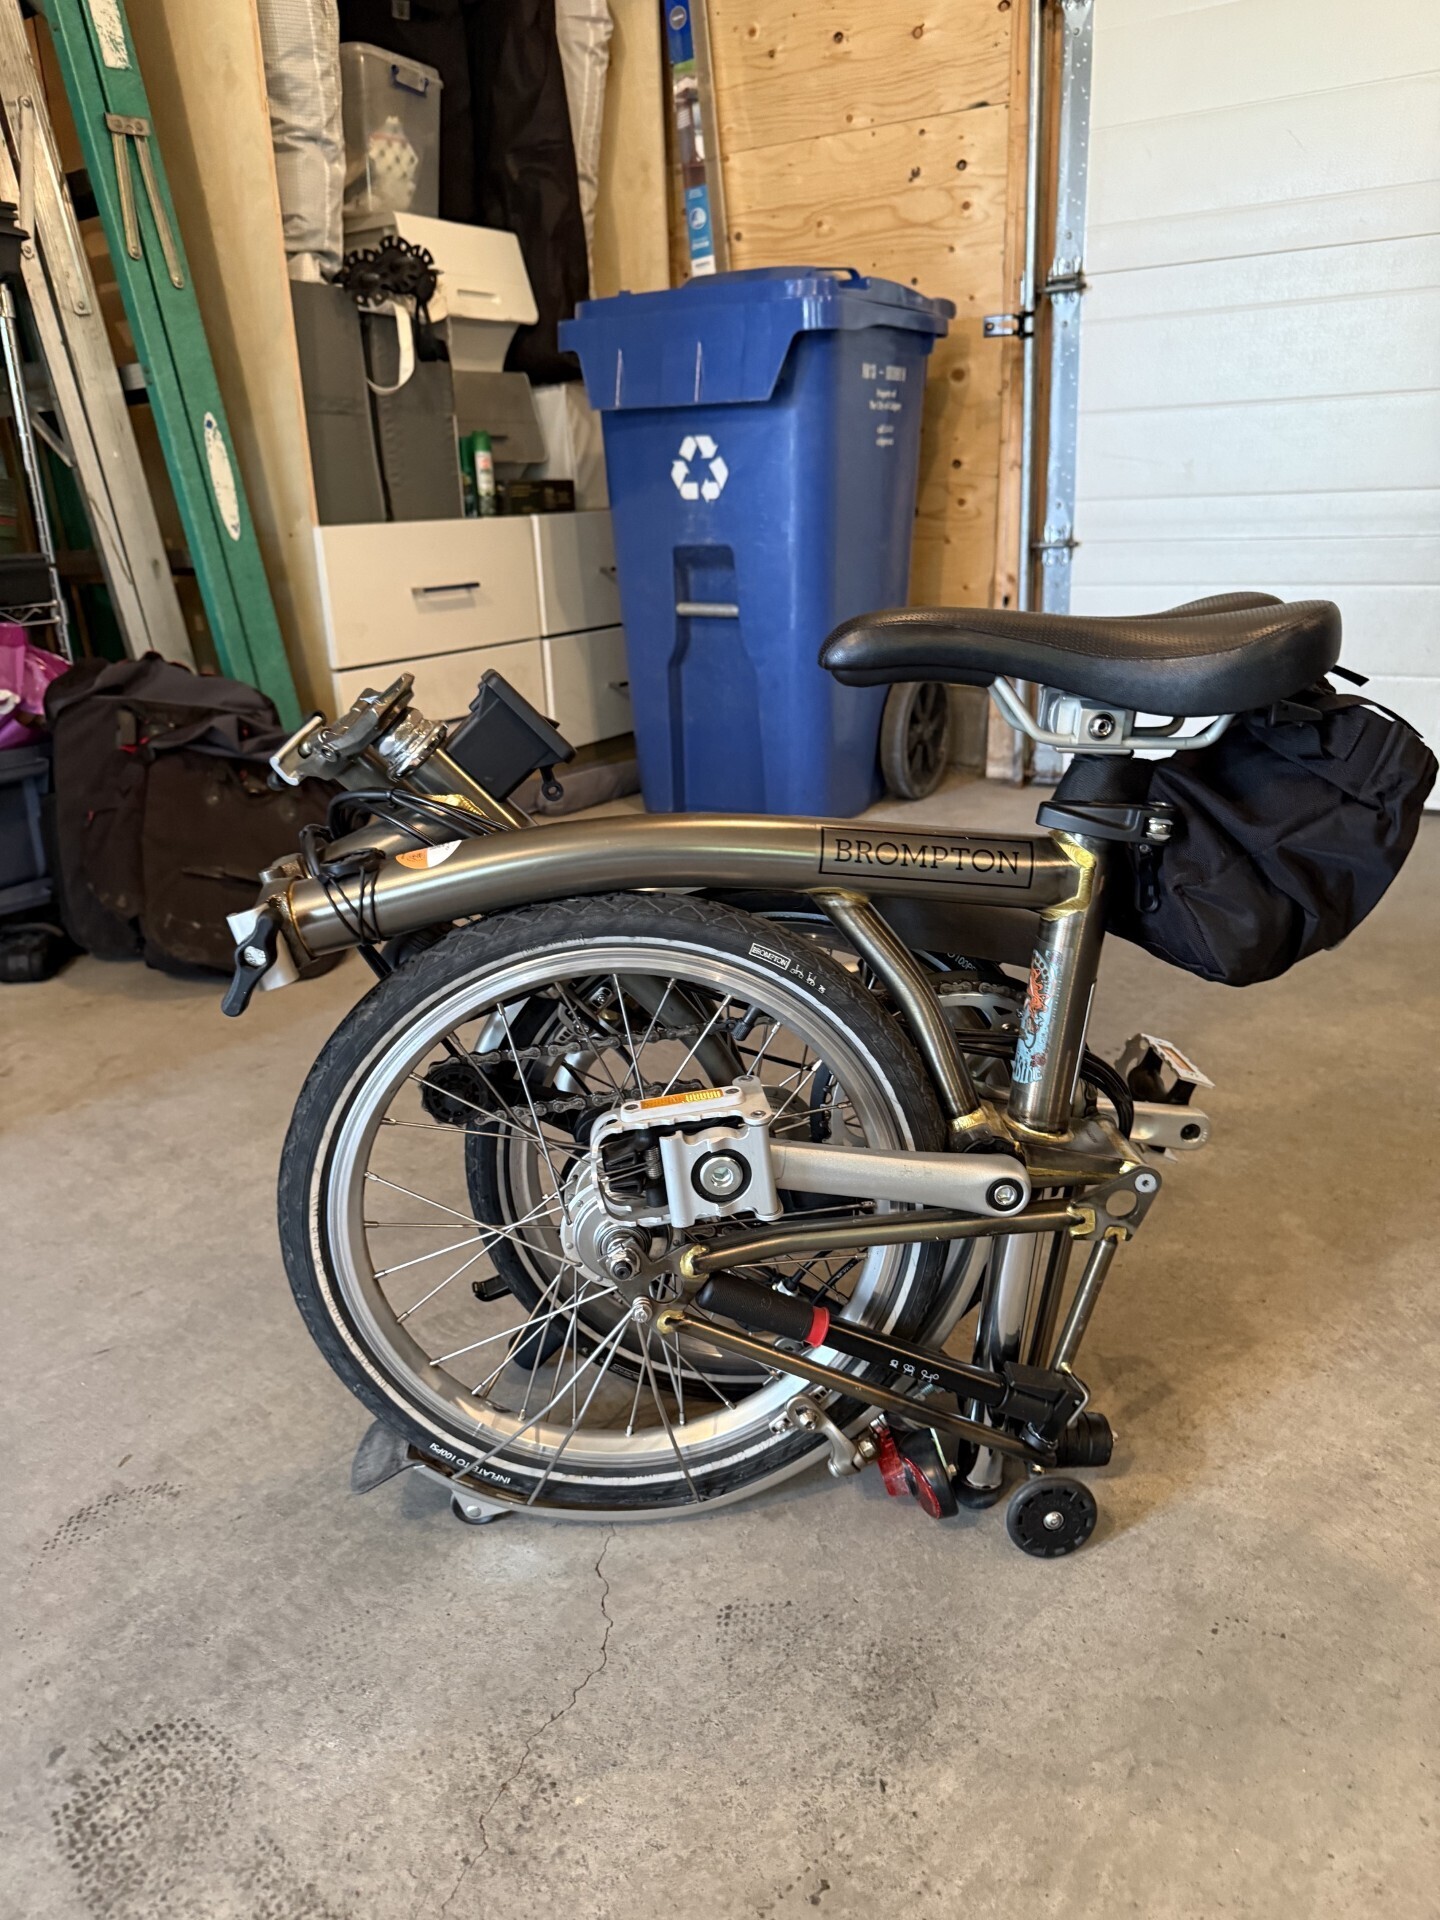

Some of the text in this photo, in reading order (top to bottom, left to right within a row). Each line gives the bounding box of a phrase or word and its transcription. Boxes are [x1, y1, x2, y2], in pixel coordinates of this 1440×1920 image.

[834, 838, 1020, 875] BROMPTON
[751, 946, 788, 967] BROMPTON
[429, 1442, 511, 1484] INFLATE TO 100PSI
